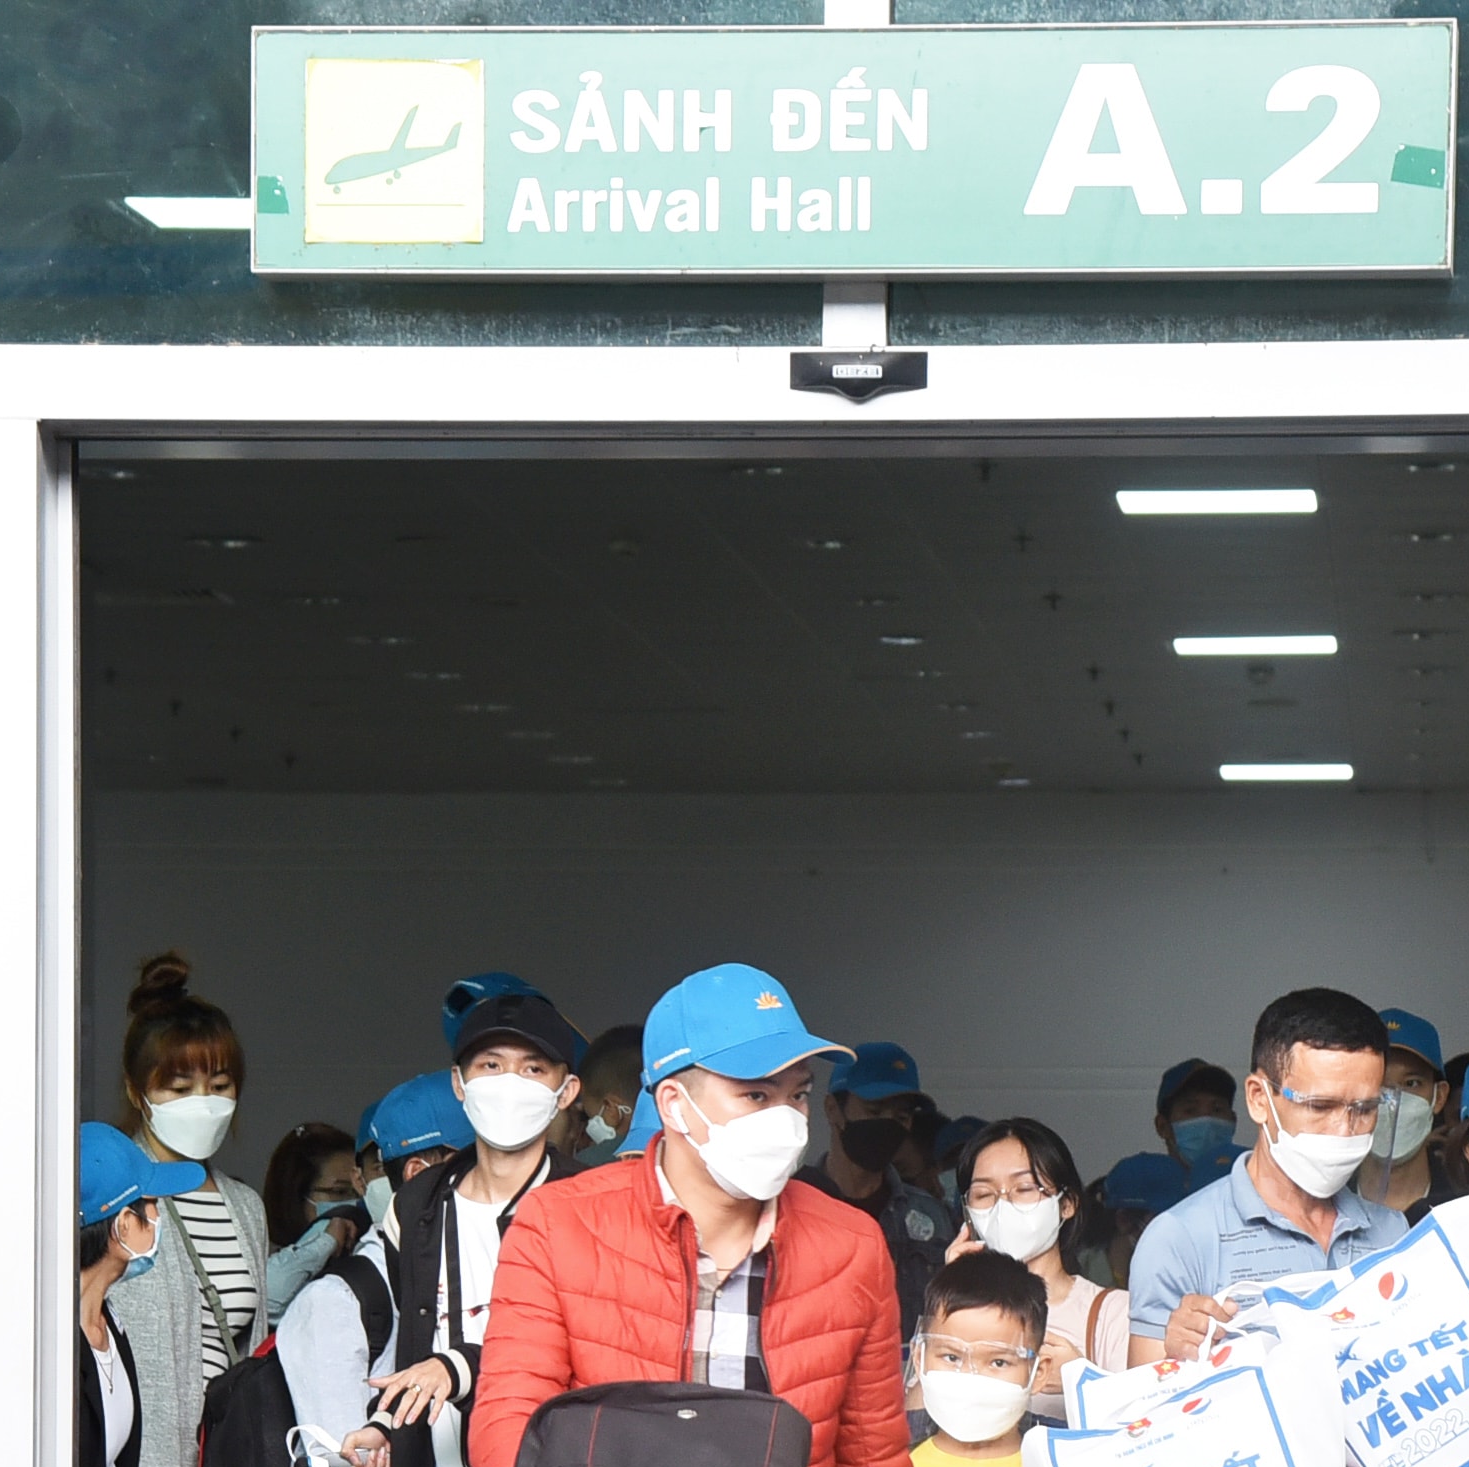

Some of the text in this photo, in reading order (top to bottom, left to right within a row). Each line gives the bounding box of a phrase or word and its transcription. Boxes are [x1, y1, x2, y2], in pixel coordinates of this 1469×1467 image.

[509, 65, 929, 155] SẢNH ĐẾN
[1021, 61, 1383, 217] A.2
[505, 175, 873, 236] Arrival Hall
[1407, 1319, 1469, 1357] TẾT
[1357, 1388, 1408, 1449] VỀ
